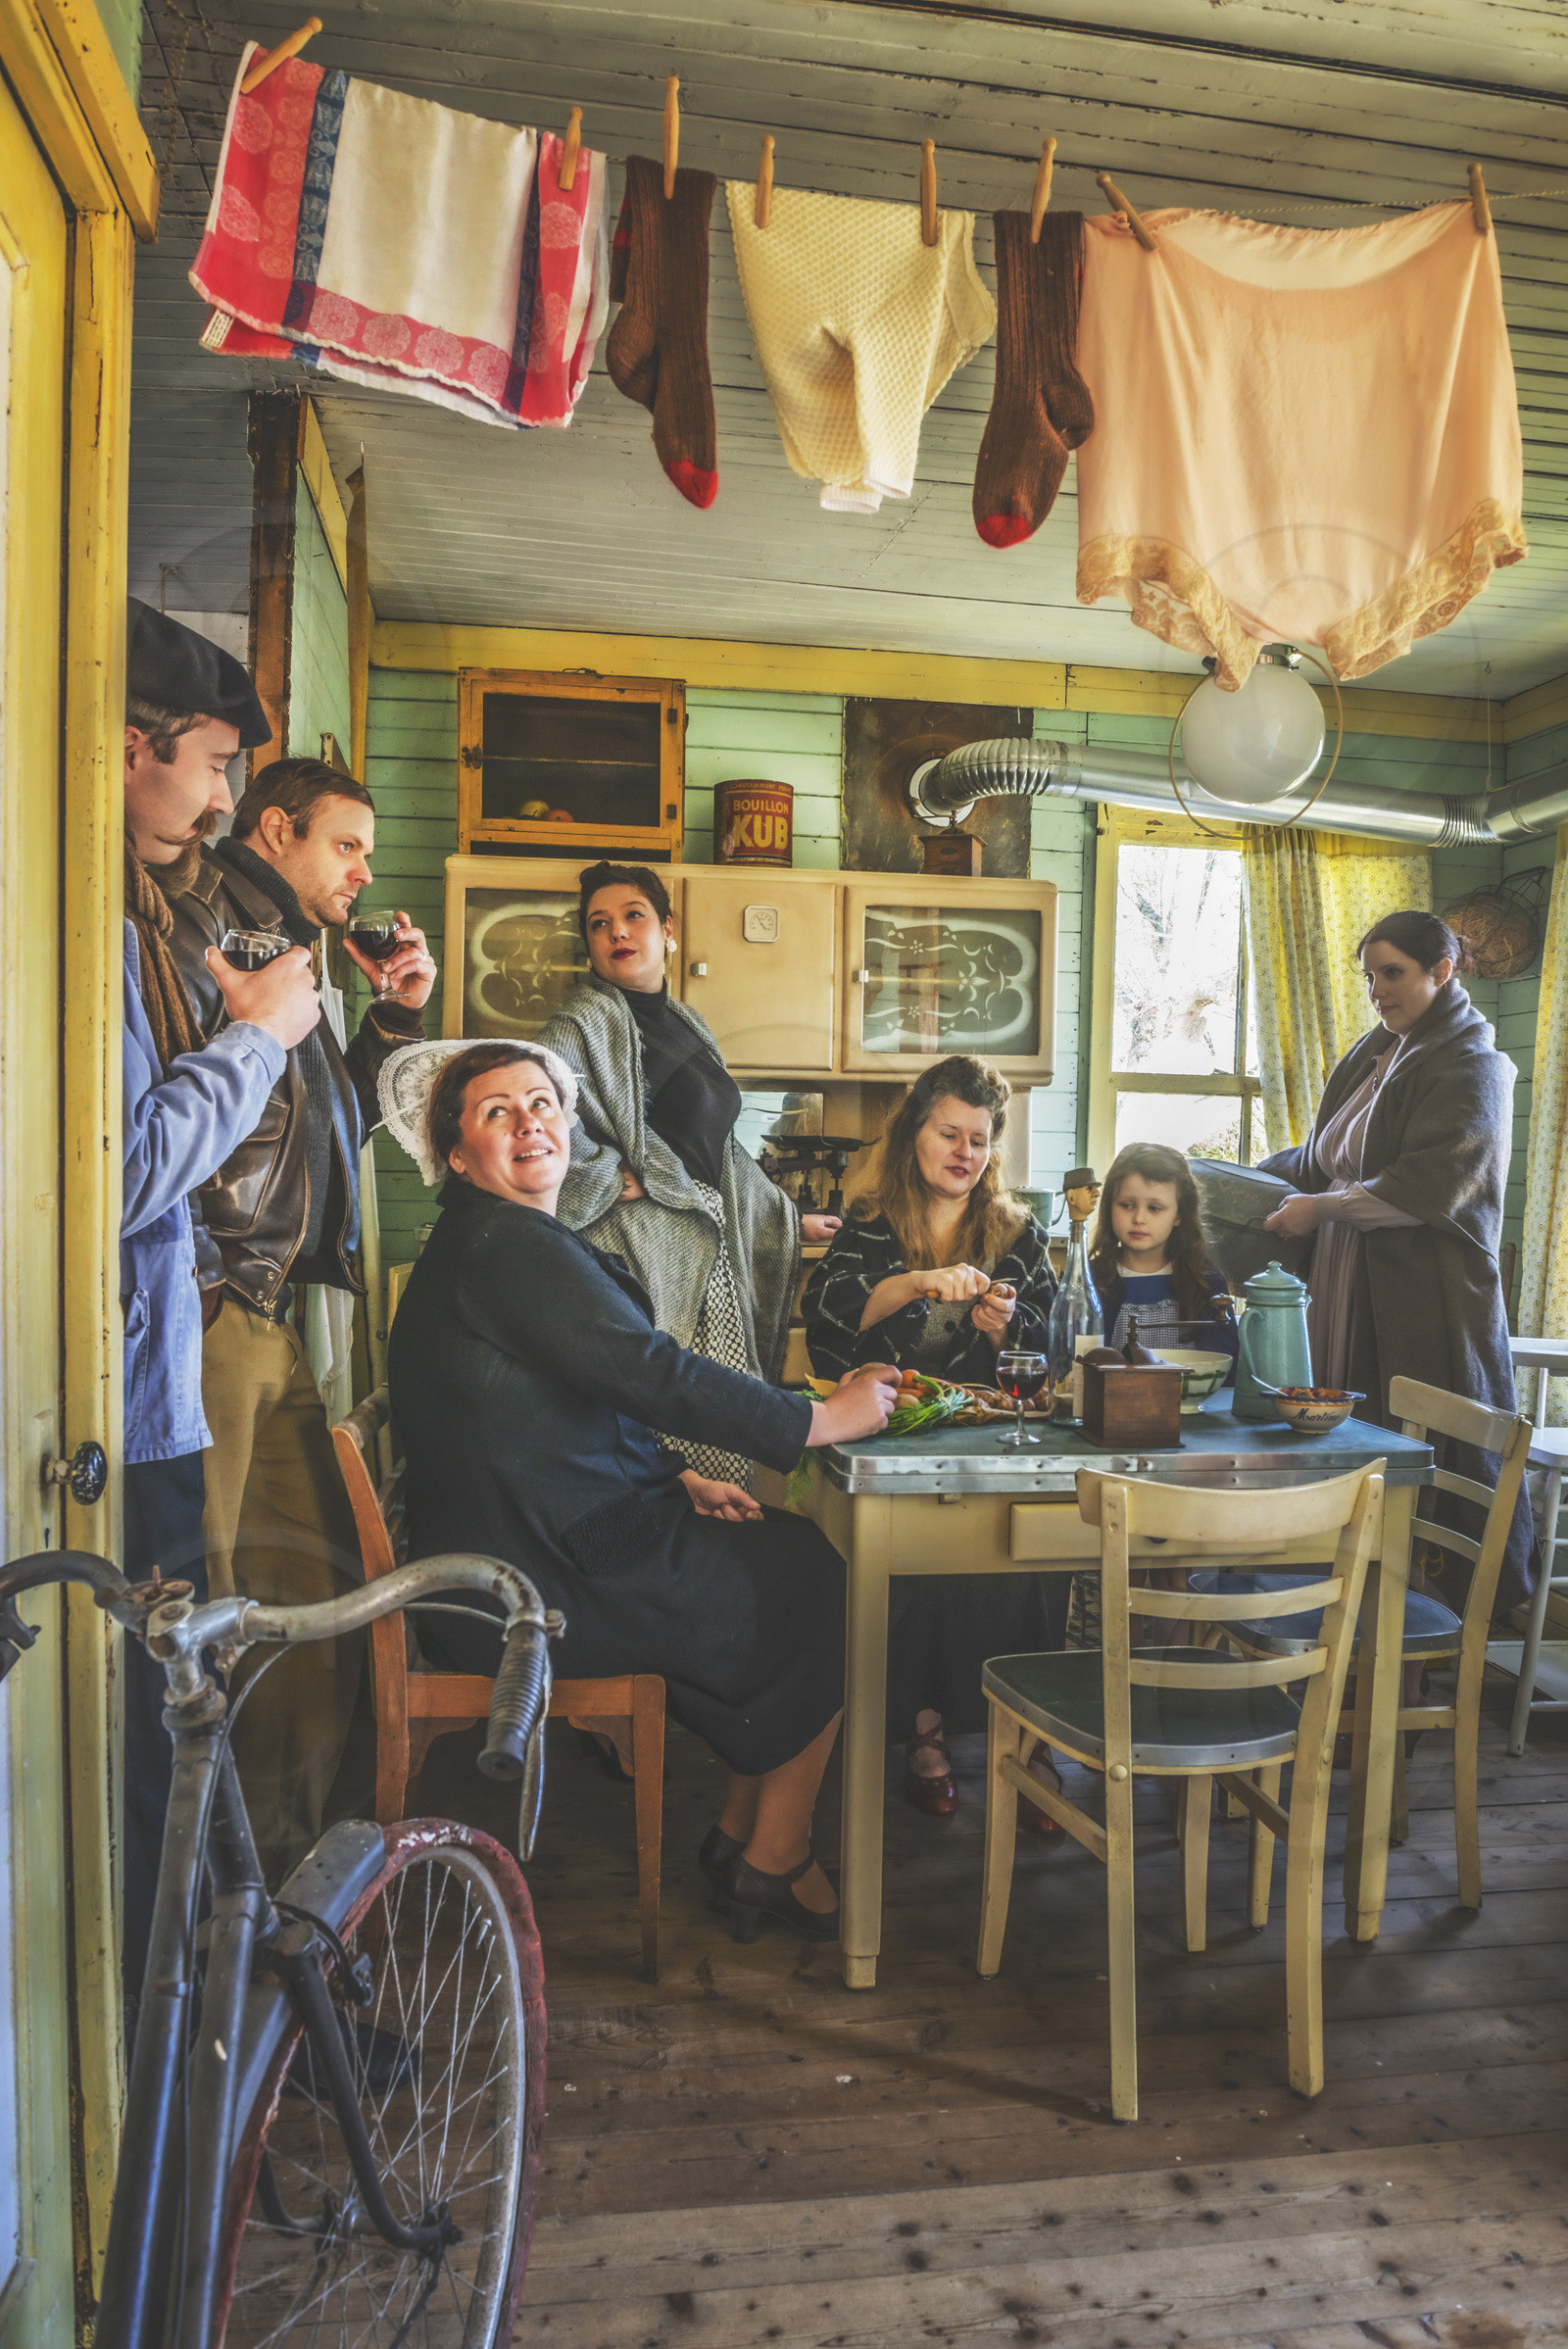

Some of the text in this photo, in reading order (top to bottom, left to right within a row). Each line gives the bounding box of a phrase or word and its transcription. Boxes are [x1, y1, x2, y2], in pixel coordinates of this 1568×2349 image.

[733, 799, 789, 814] BOUILLON
[733, 814, 789, 850] KUB
[1293, 1407, 1341, 1422] Martine
